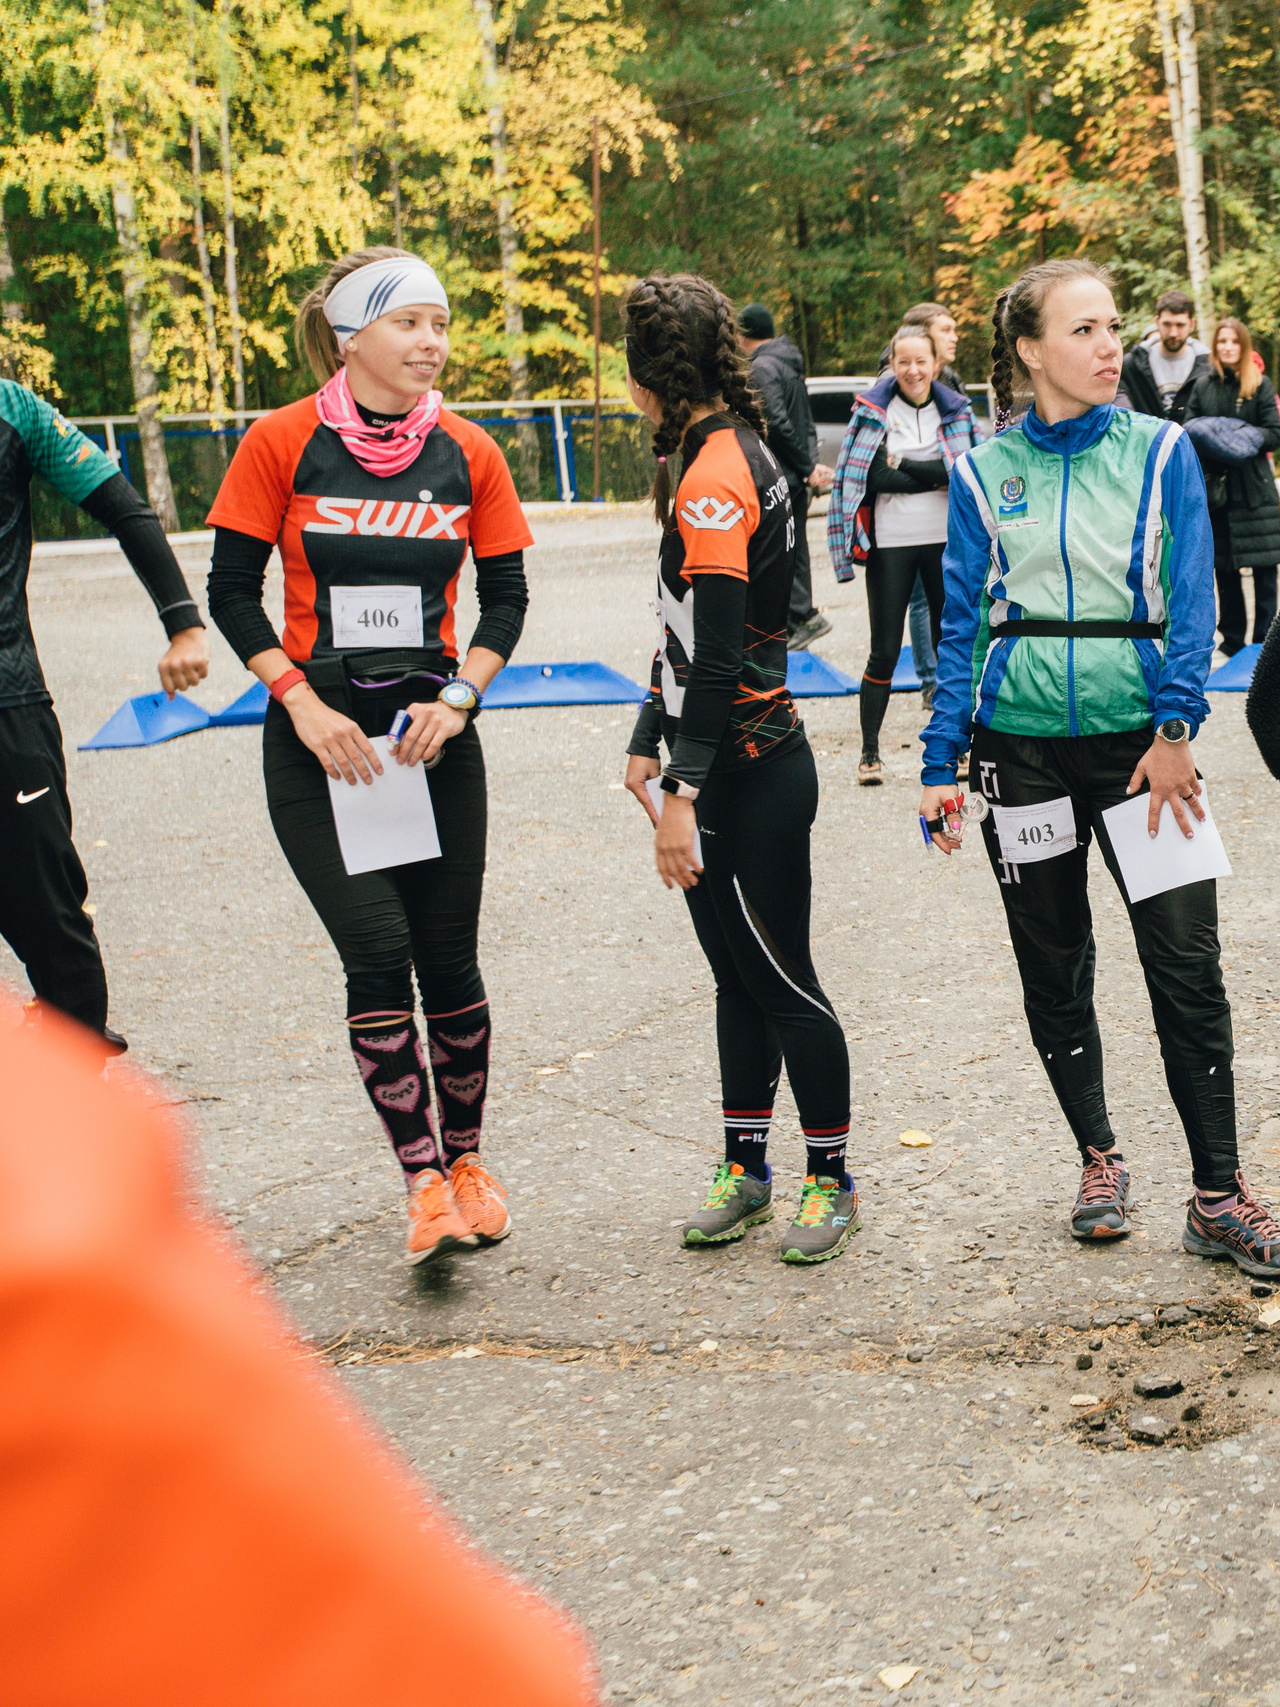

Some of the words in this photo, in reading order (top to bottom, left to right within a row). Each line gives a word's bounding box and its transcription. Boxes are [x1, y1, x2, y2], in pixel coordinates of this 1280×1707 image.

[358, 608, 399, 628] 406
[1018, 823, 1054, 845] 403
[382, 1081, 415, 1101] LOVER
[447, 1078, 480, 1092] LOVER
